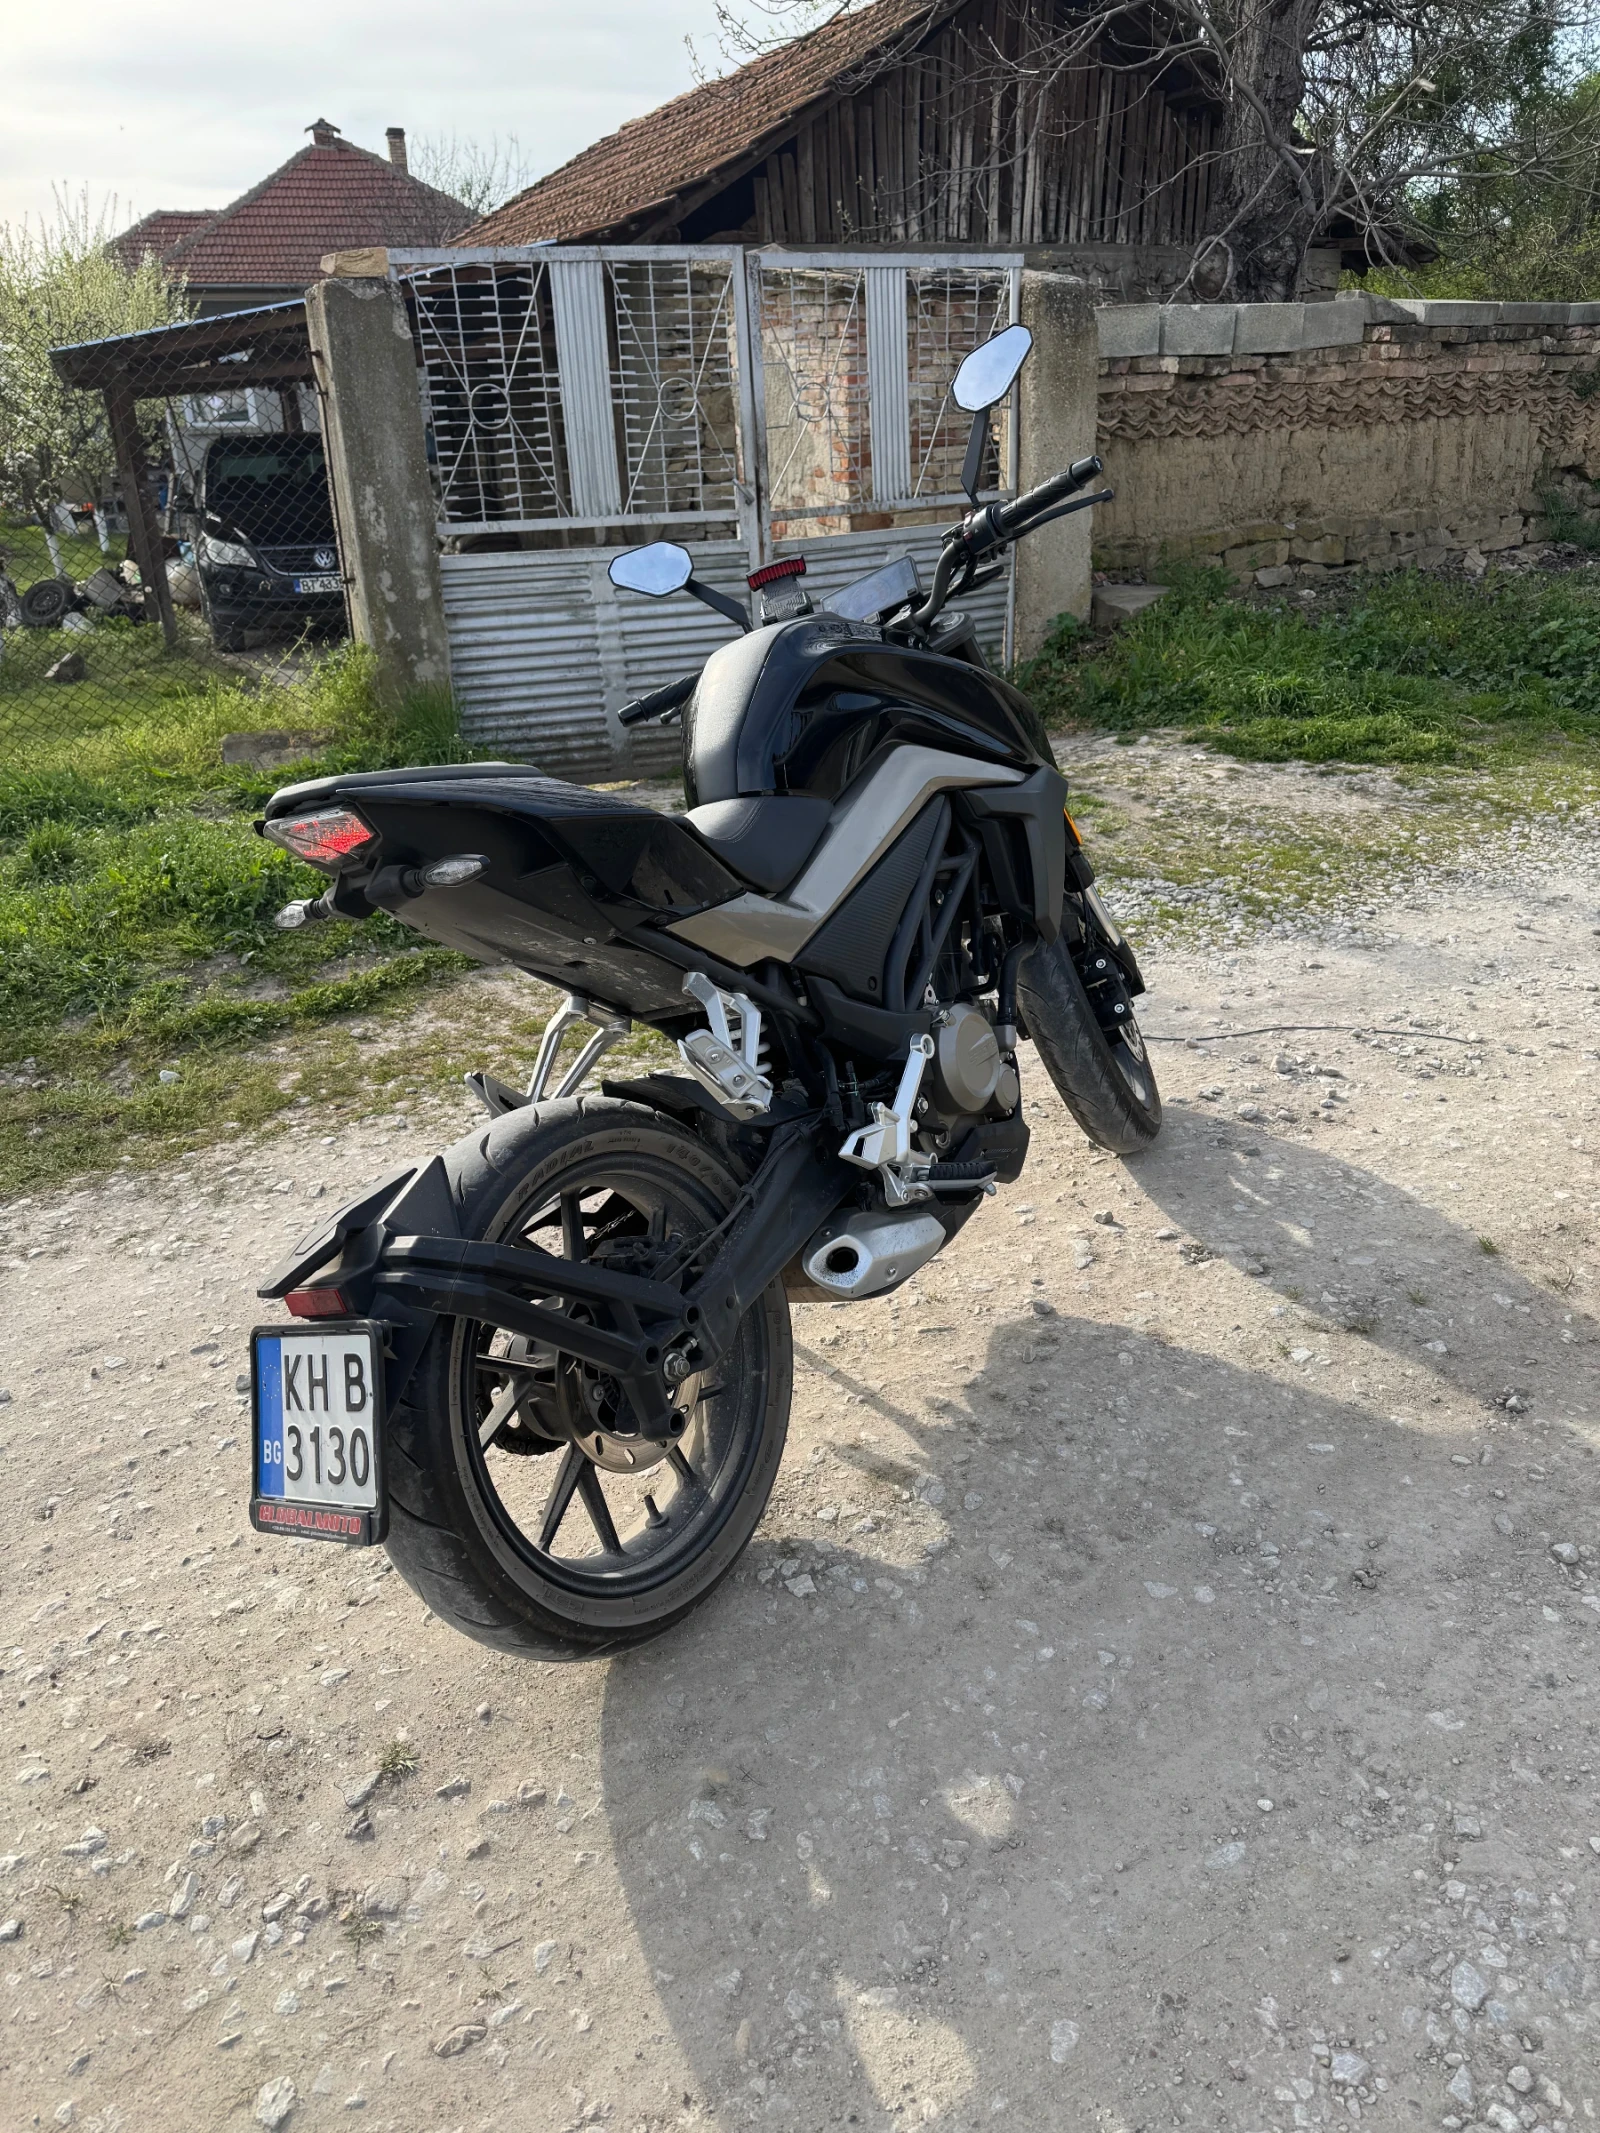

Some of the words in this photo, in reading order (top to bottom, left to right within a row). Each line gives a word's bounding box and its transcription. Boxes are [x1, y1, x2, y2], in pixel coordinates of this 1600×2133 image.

[263, 1439, 282, 1465] BG
[286, 1425, 370, 1487] 3130
[259, 1506, 361, 1534] GLOBALMOTO
